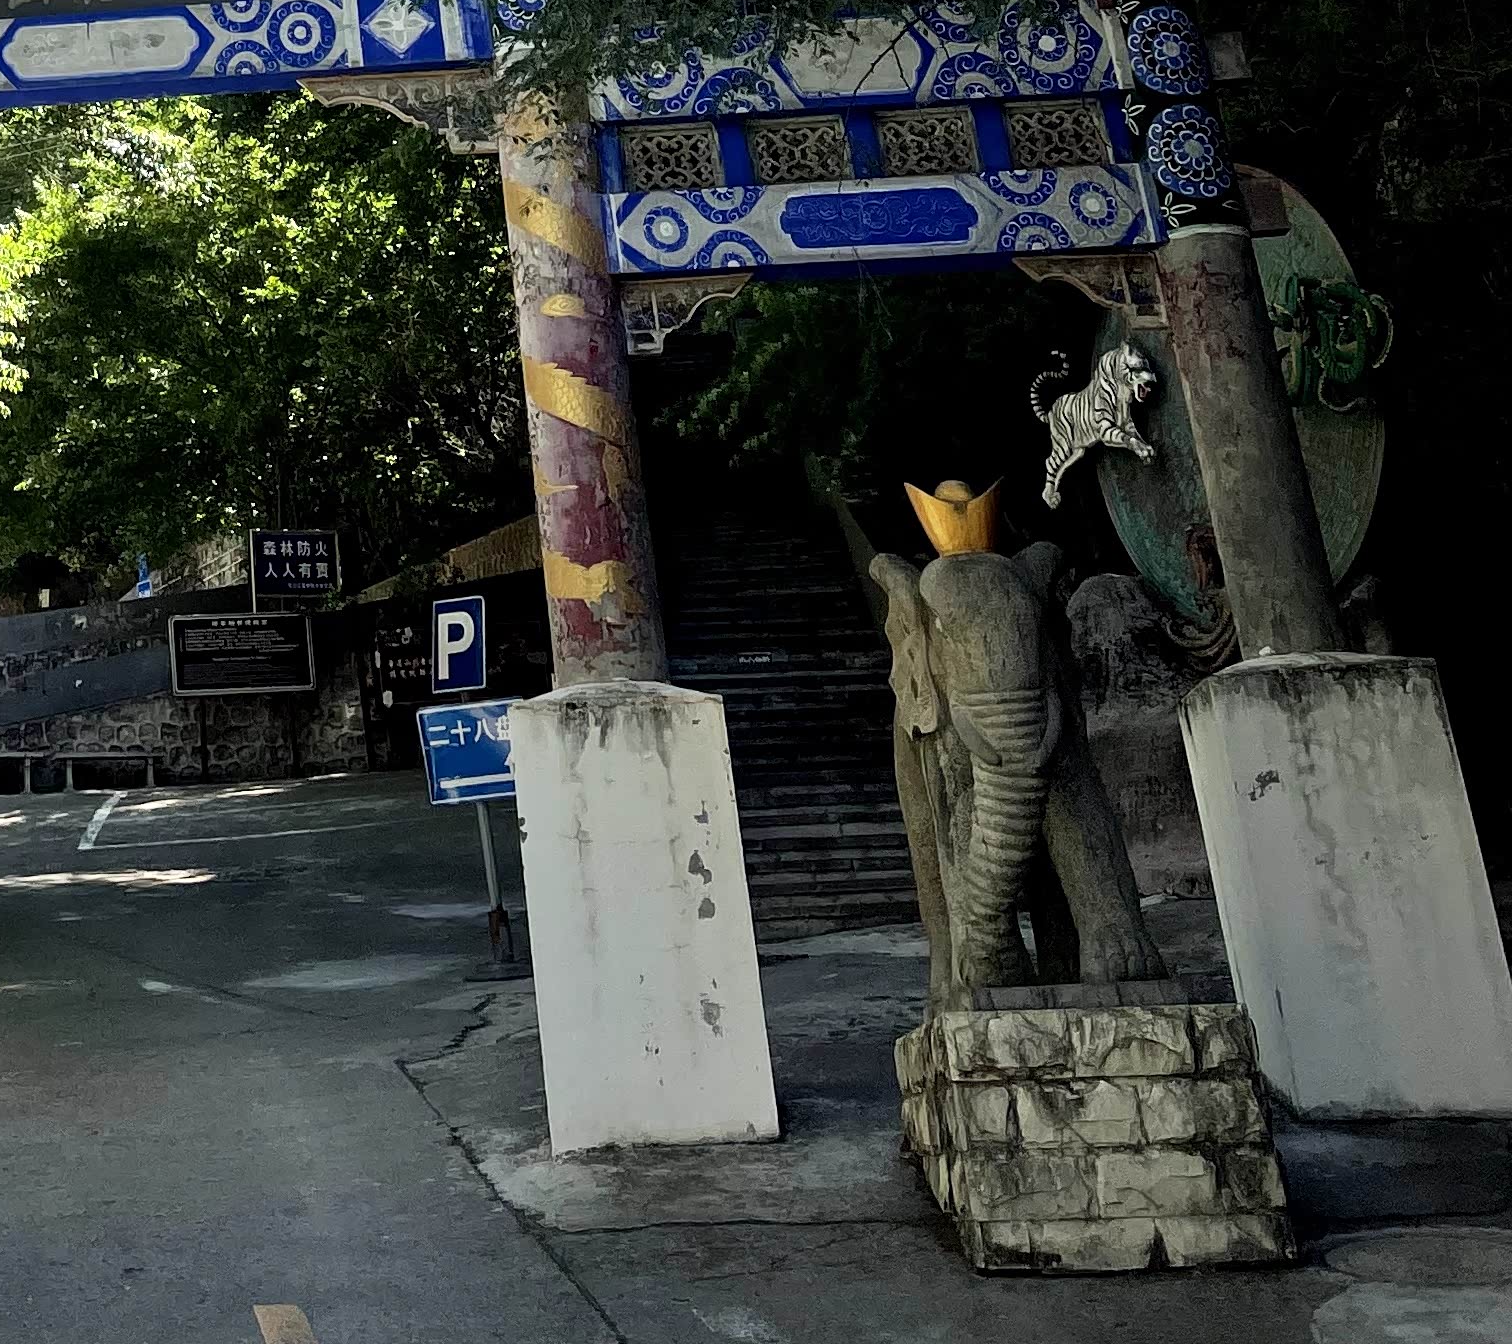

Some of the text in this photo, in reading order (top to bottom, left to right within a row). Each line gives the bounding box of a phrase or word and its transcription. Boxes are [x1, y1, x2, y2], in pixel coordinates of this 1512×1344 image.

[263, 540, 329, 556] 森林防火
[264, 562, 329, 579] 人人有责
[437, 610, 475, 681] P
